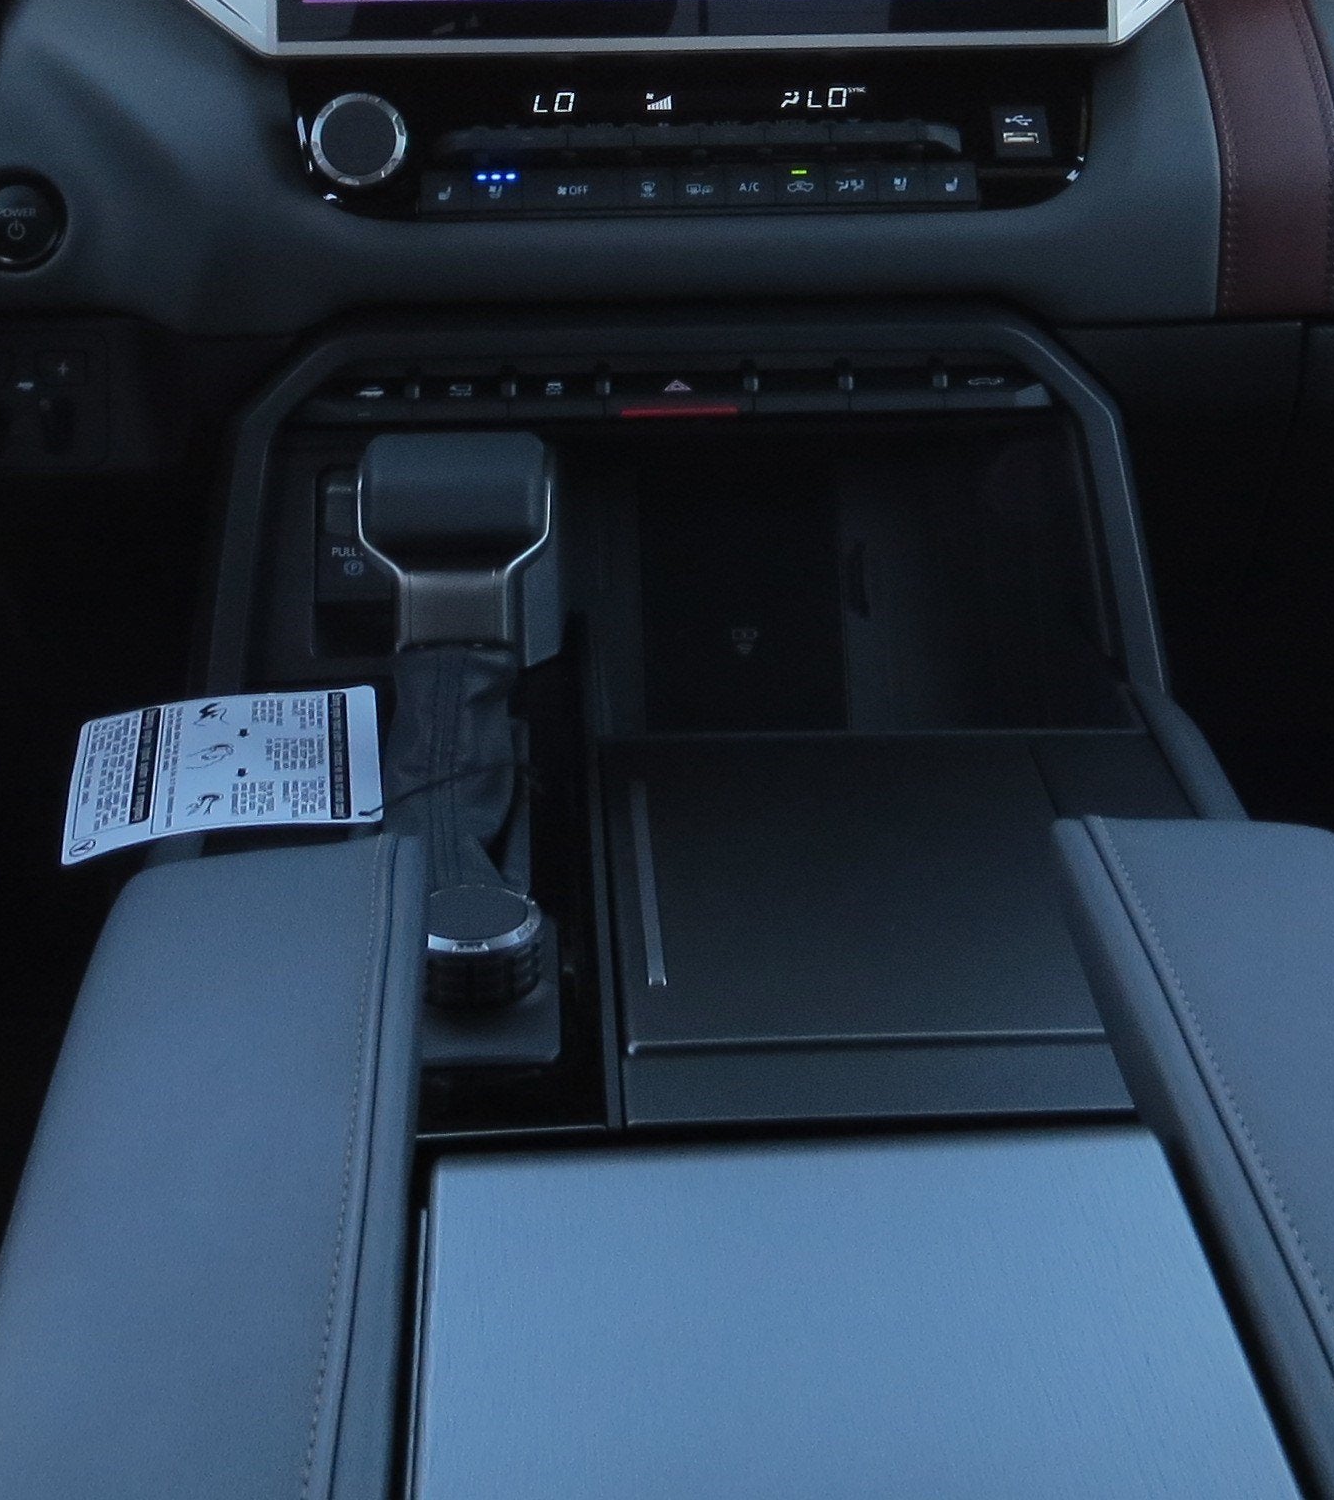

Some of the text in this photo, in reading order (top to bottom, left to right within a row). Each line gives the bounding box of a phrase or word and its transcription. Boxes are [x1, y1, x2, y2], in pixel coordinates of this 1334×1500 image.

[568, 185, 589, 196] OFF
[738, 182, 761, 194] A/C
[331, 546, 358, 557] PULL
